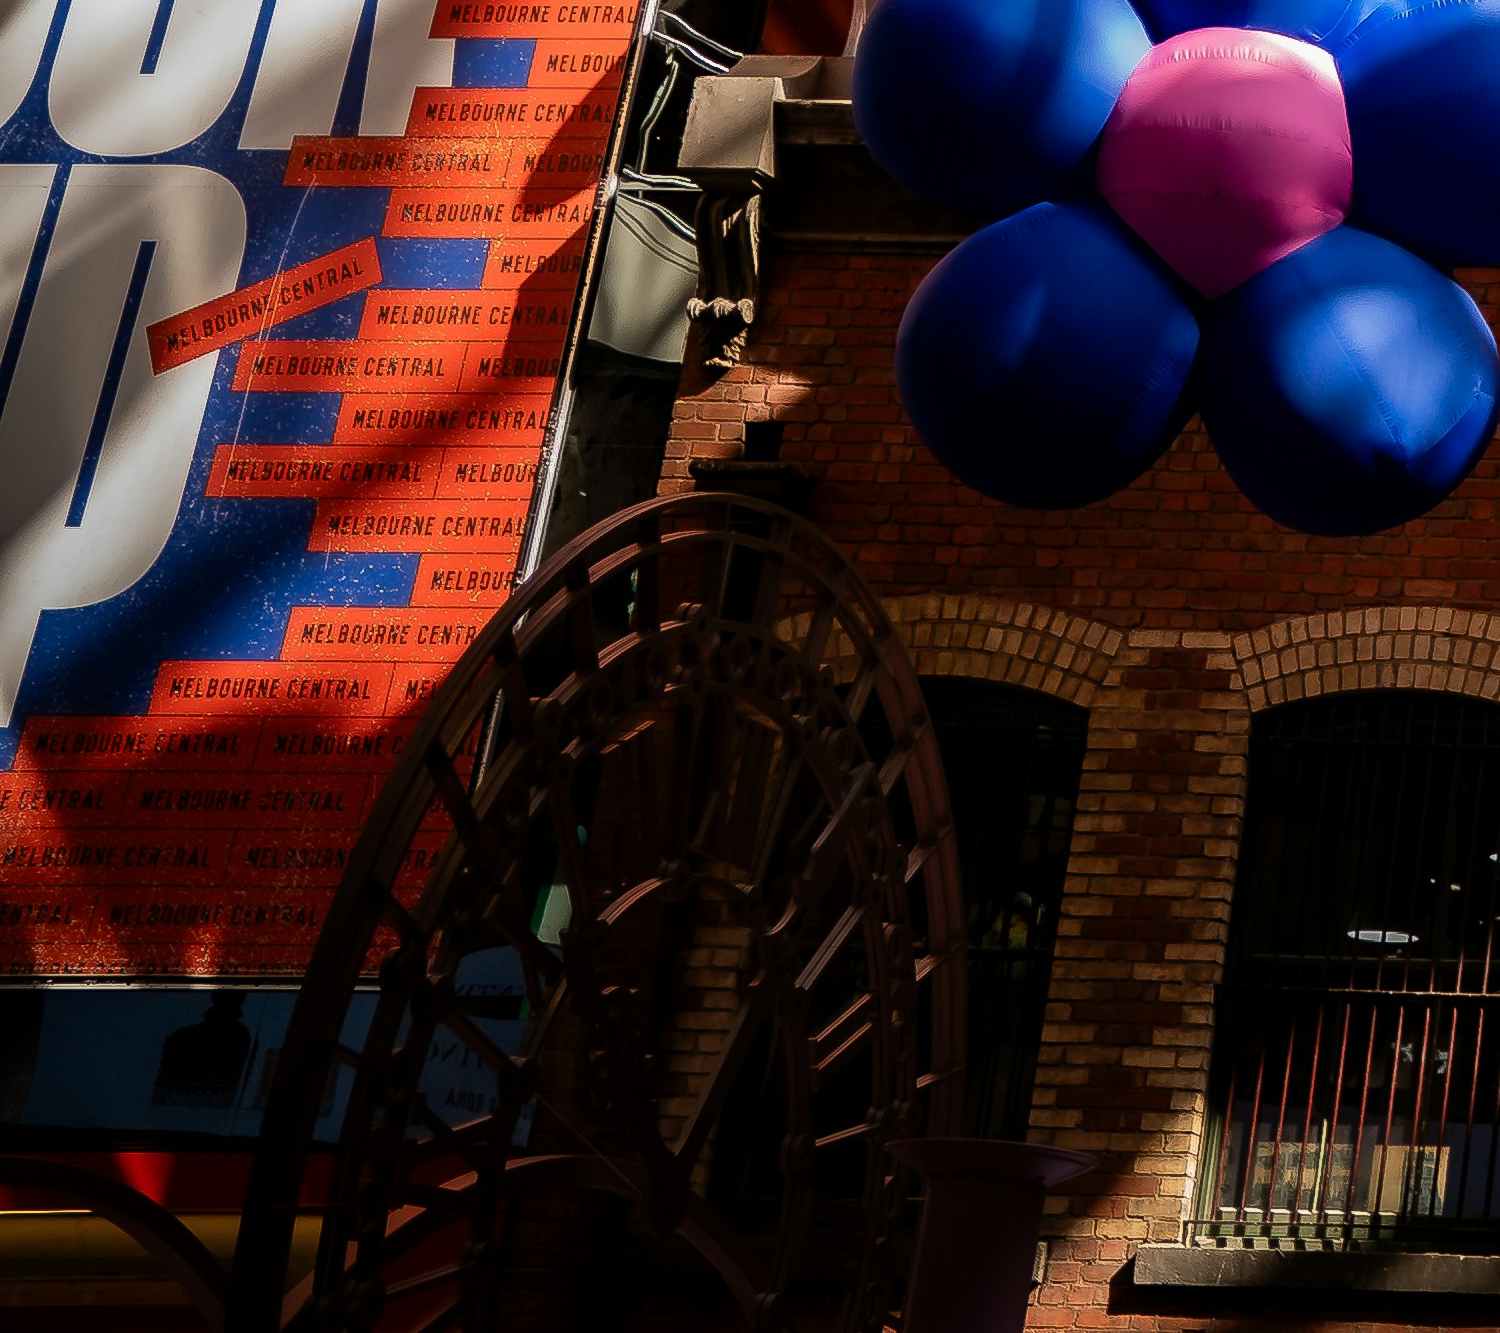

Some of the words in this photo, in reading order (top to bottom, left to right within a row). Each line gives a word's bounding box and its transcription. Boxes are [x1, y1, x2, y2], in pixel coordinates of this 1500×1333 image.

[449, 4, 552, 24] MELBOURNE
[557, 5, 635, 24] CENTRAL
[424, 102, 528, 123] MELBOURNE
[533, 102, 612, 123] CENTRAL
[302, 151, 406, 173] MELBOURNE
[409, 151, 492, 173] CENTRAL
[400, 202, 504, 224] MELBOURNE
[510, 202, 592, 224] CENTRAL
[166, 293, 274, 353] MELBOURNE
[280, 257, 365, 306] CENTRAL
[376, 305, 482, 326] MELBOURNE
[488, 305, 570, 326] CENTRAL
[252, 356, 359, 378] MELBOURNE
[363, 356, 446, 378] CENTRAL
[353, 409, 458, 431] MELBOURNE
[464, 409, 548, 431] CENTRAL
[0, 164, 247, 728] P
[227, 461, 334, 484] MELBOURNE
[339, 461, 423, 484] CENTRAL
[326, 515, 436, 538] MELBOURNE
[441, 516, 526, 538] CENTRAL
[300, 622, 410, 645] MELBOURNE
[416, 622, 478, 646] CENTR
[167, 676, 282, 701] MELBOURNE
[285, 677, 372, 701] CENTRAL
[34, 732, 149, 755] MELBOURNE
[153, 732, 241, 755] CENTRAL
[273, 733, 385, 757] MELBOURNE
[18, 788, 105, 811] CENTRAL
[138, 789, 252, 812] MELBOURNE
[258, 790, 344, 813] CENTRAL
[2, 844, 118, 868] MELBOURNE
[121, 844, 210, 868] CENTRAL
[108, 903, 224, 926] MELBOURNE
[229, 904, 318, 926] CENTRAL
